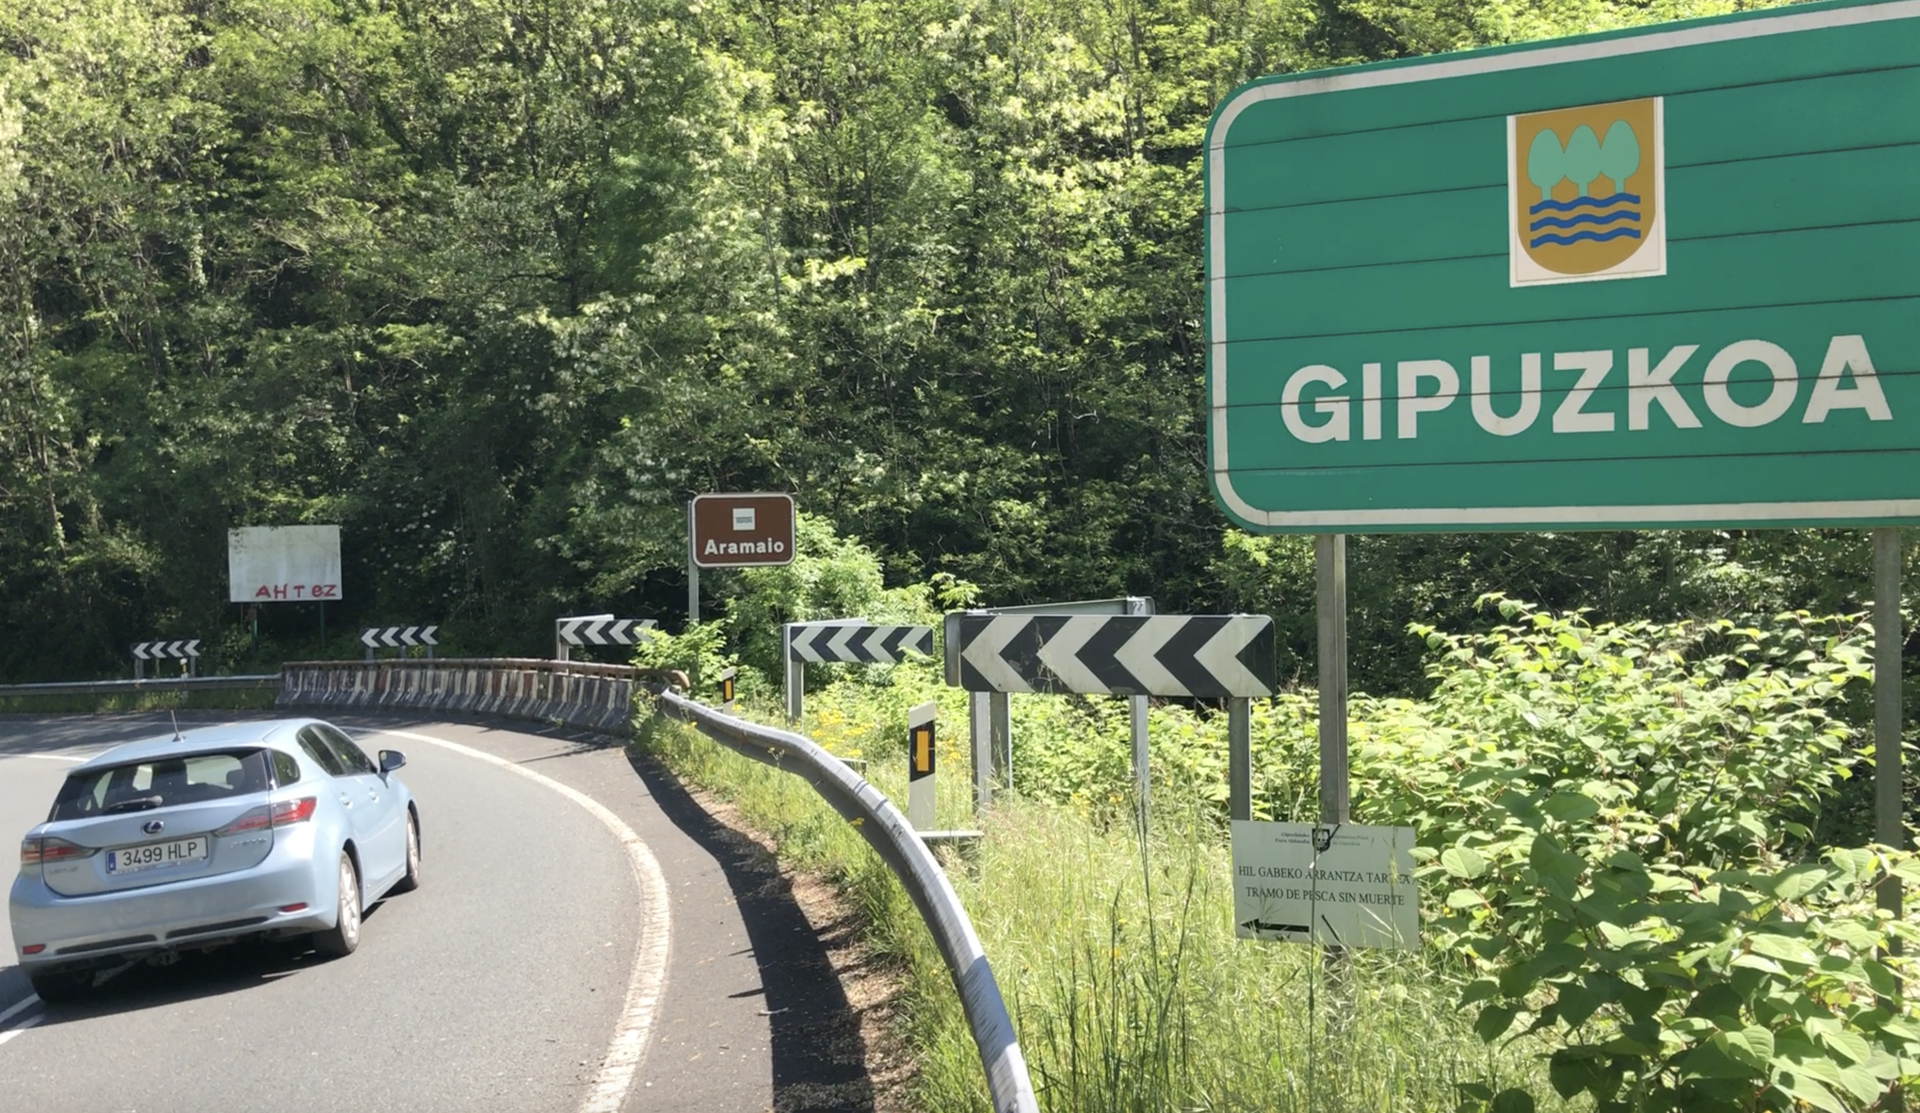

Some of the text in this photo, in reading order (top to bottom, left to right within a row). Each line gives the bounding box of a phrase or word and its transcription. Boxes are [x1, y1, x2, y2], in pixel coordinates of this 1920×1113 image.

[1281, 334, 1893, 444] GIPUZKOA
[704, 537, 785, 555] Aramaio
[122, 847, 162, 867] 3499
[168, 841, 197, 860] HLP
[1238, 865, 1411, 885] HIL GABEKO ARRANTZA TAREA
[1245, 886, 1405, 906] TRAMO DE PESCA SIN MUERTE
